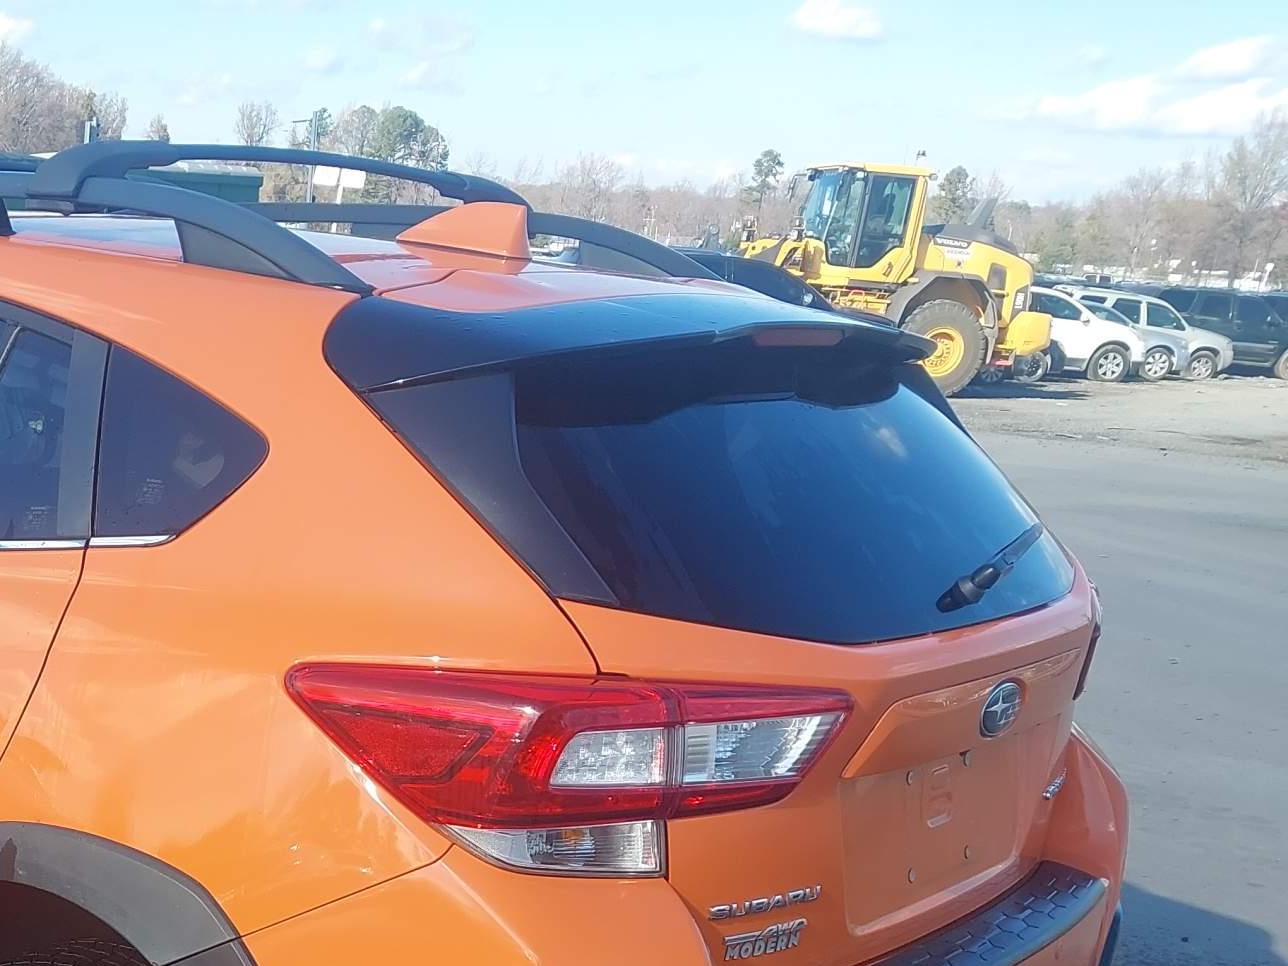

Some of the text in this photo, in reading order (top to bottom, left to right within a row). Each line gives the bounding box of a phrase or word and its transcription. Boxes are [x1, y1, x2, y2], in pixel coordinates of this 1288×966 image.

[935, 237, 968, 247] VOLVO
[708, 885, 822, 920] SUBARU
[724, 930, 800, 961] MODERN
